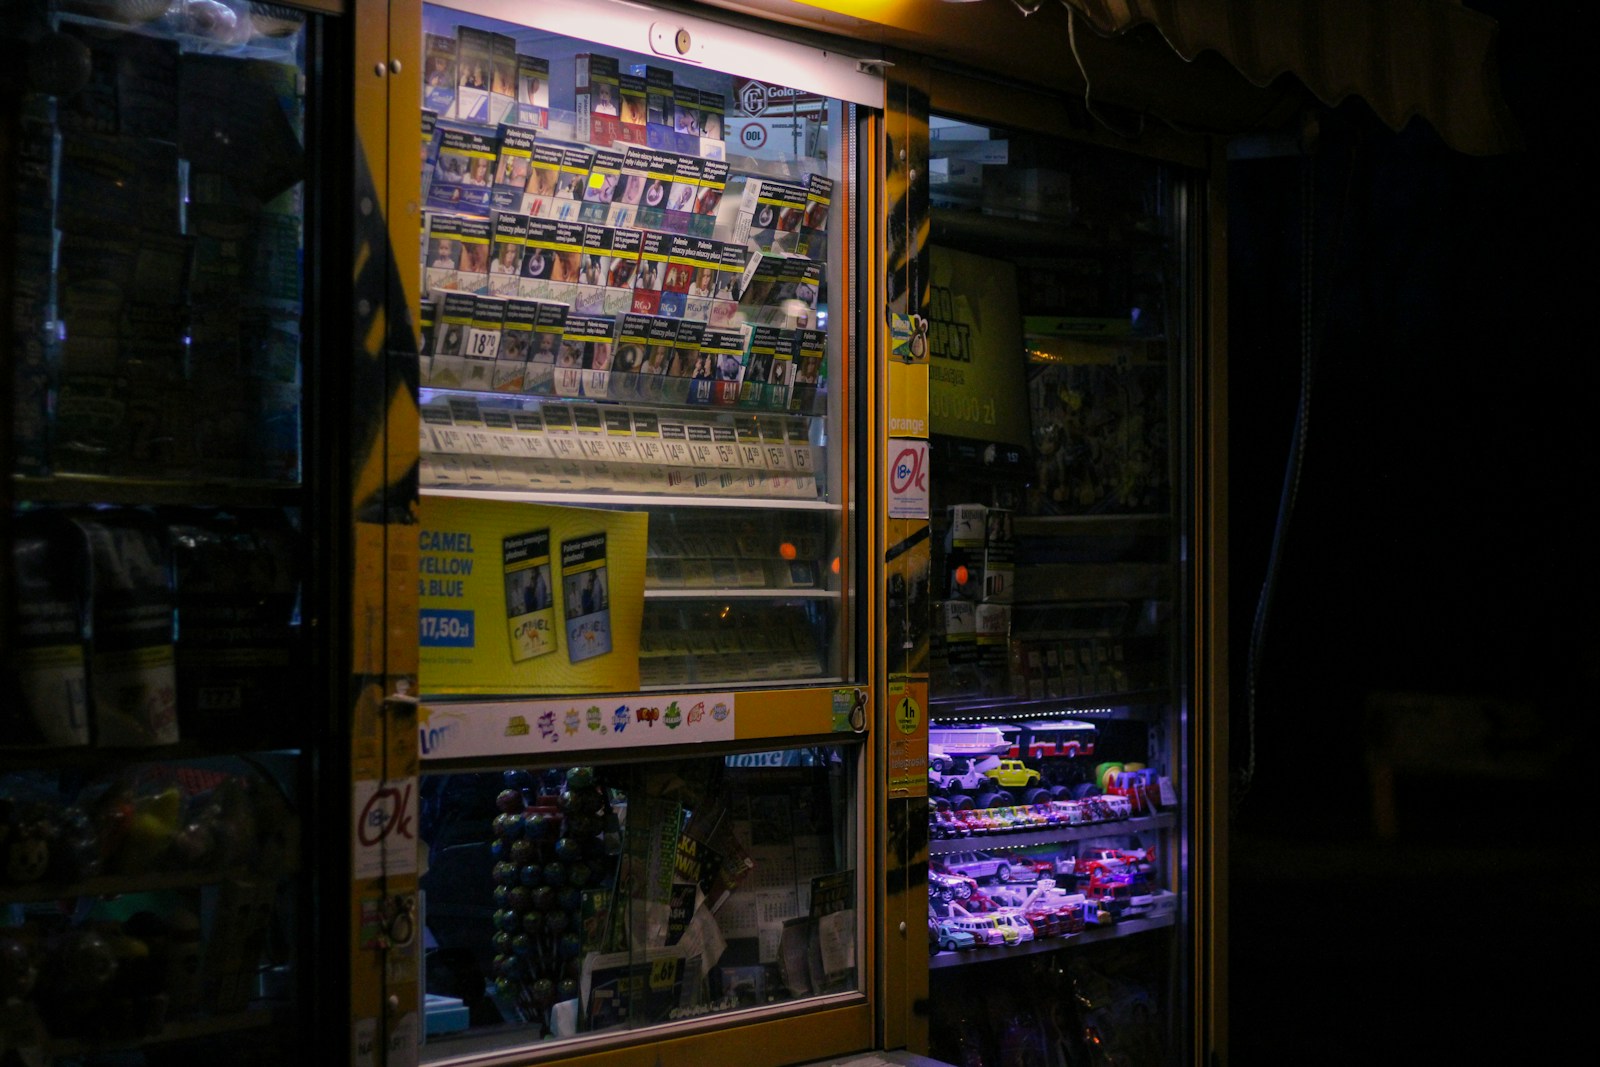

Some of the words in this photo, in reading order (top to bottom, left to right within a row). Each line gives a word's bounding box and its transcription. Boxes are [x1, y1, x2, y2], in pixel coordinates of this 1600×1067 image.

[746, 131, 761, 141] 100
[473, 333, 487, 354] 18
[890, 418, 924, 432] orange
[890, 447, 926, 494] Ok
[896, 464, 911, 480] 18+
[419, 531, 475, 552] CAMEL
[563, 542, 581, 553] Palenie
[429, 580, 464, 598] BLUE
[514, 618, 551, 640] CAMEL
[571, 620, 607, 641] CAMEL
[358, 784, 413, 847] Ok
